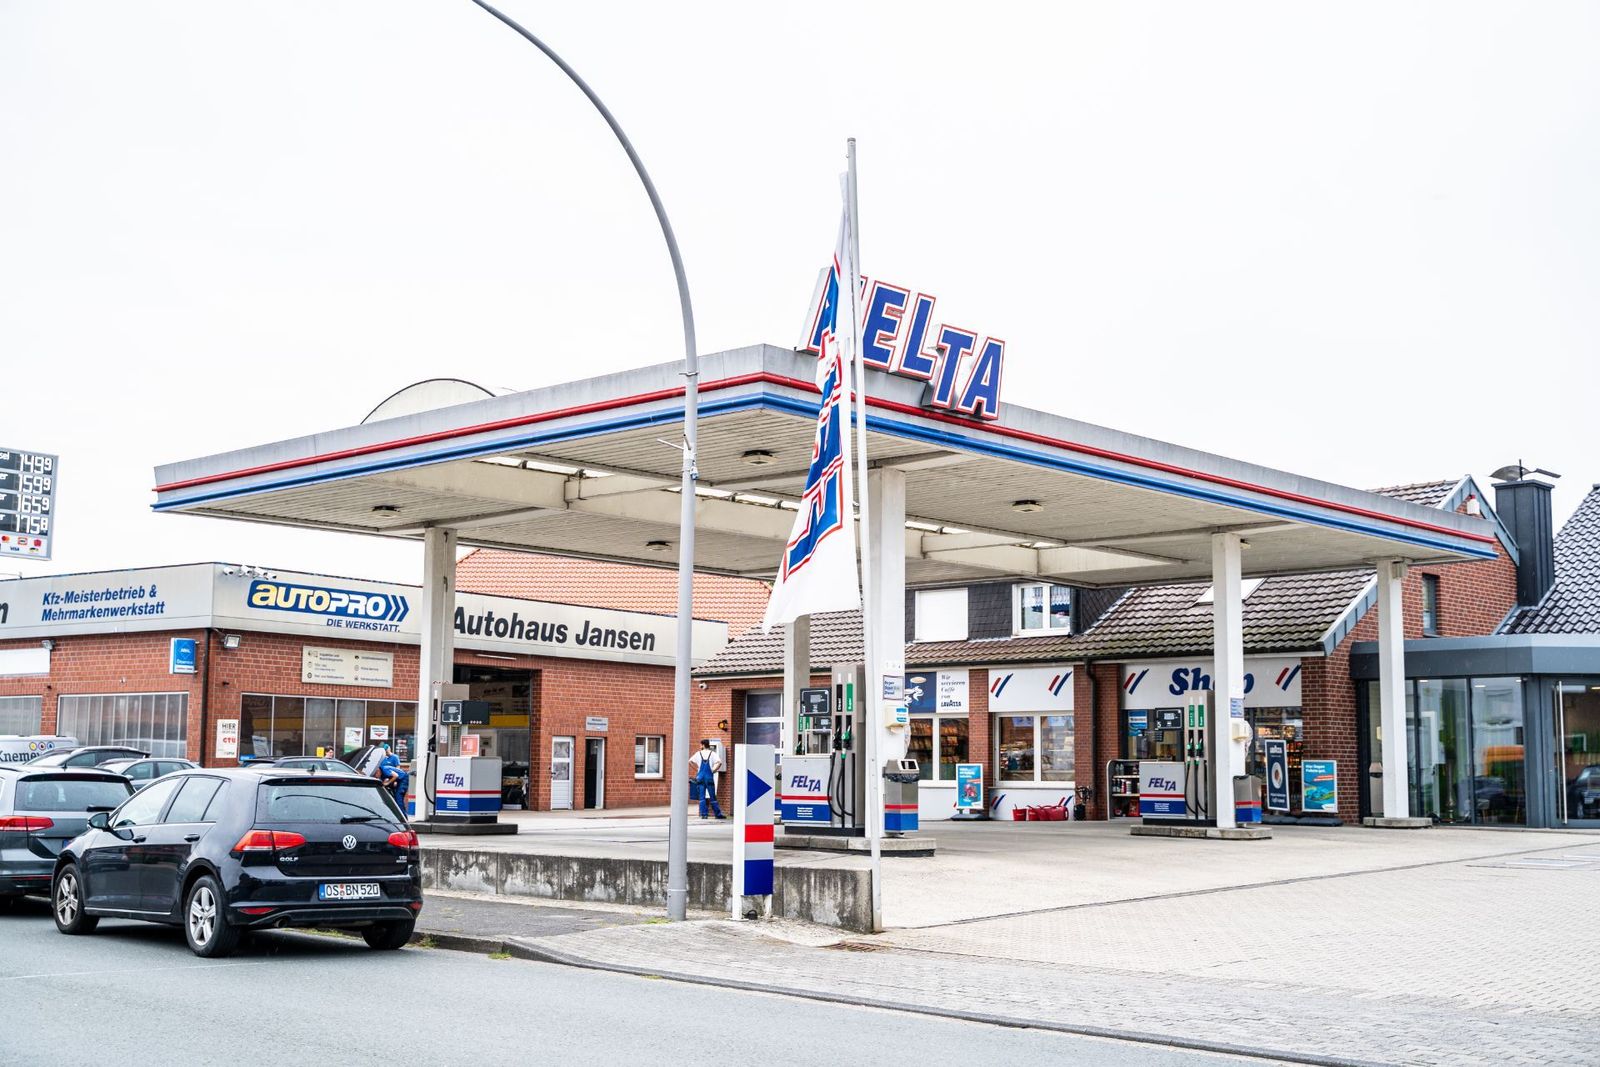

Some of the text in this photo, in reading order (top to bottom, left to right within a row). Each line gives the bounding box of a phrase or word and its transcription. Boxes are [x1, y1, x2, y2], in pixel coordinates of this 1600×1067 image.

[42, 584, 157, 606] Kfz-Meisterbetrieb &
[41, 601, 166, 622] Mehrmarkenwerkstatt
[326, 618, 342, 628] DIE
[453, 606, 656, 652] Autohaus Jansen
[443, 773, 464, 787] FELTA
[790, 775, 821, 791] FELTA
[1148, 777, 1176, 791] FELTA
[325, 883, 379, 896] OS BN 520
